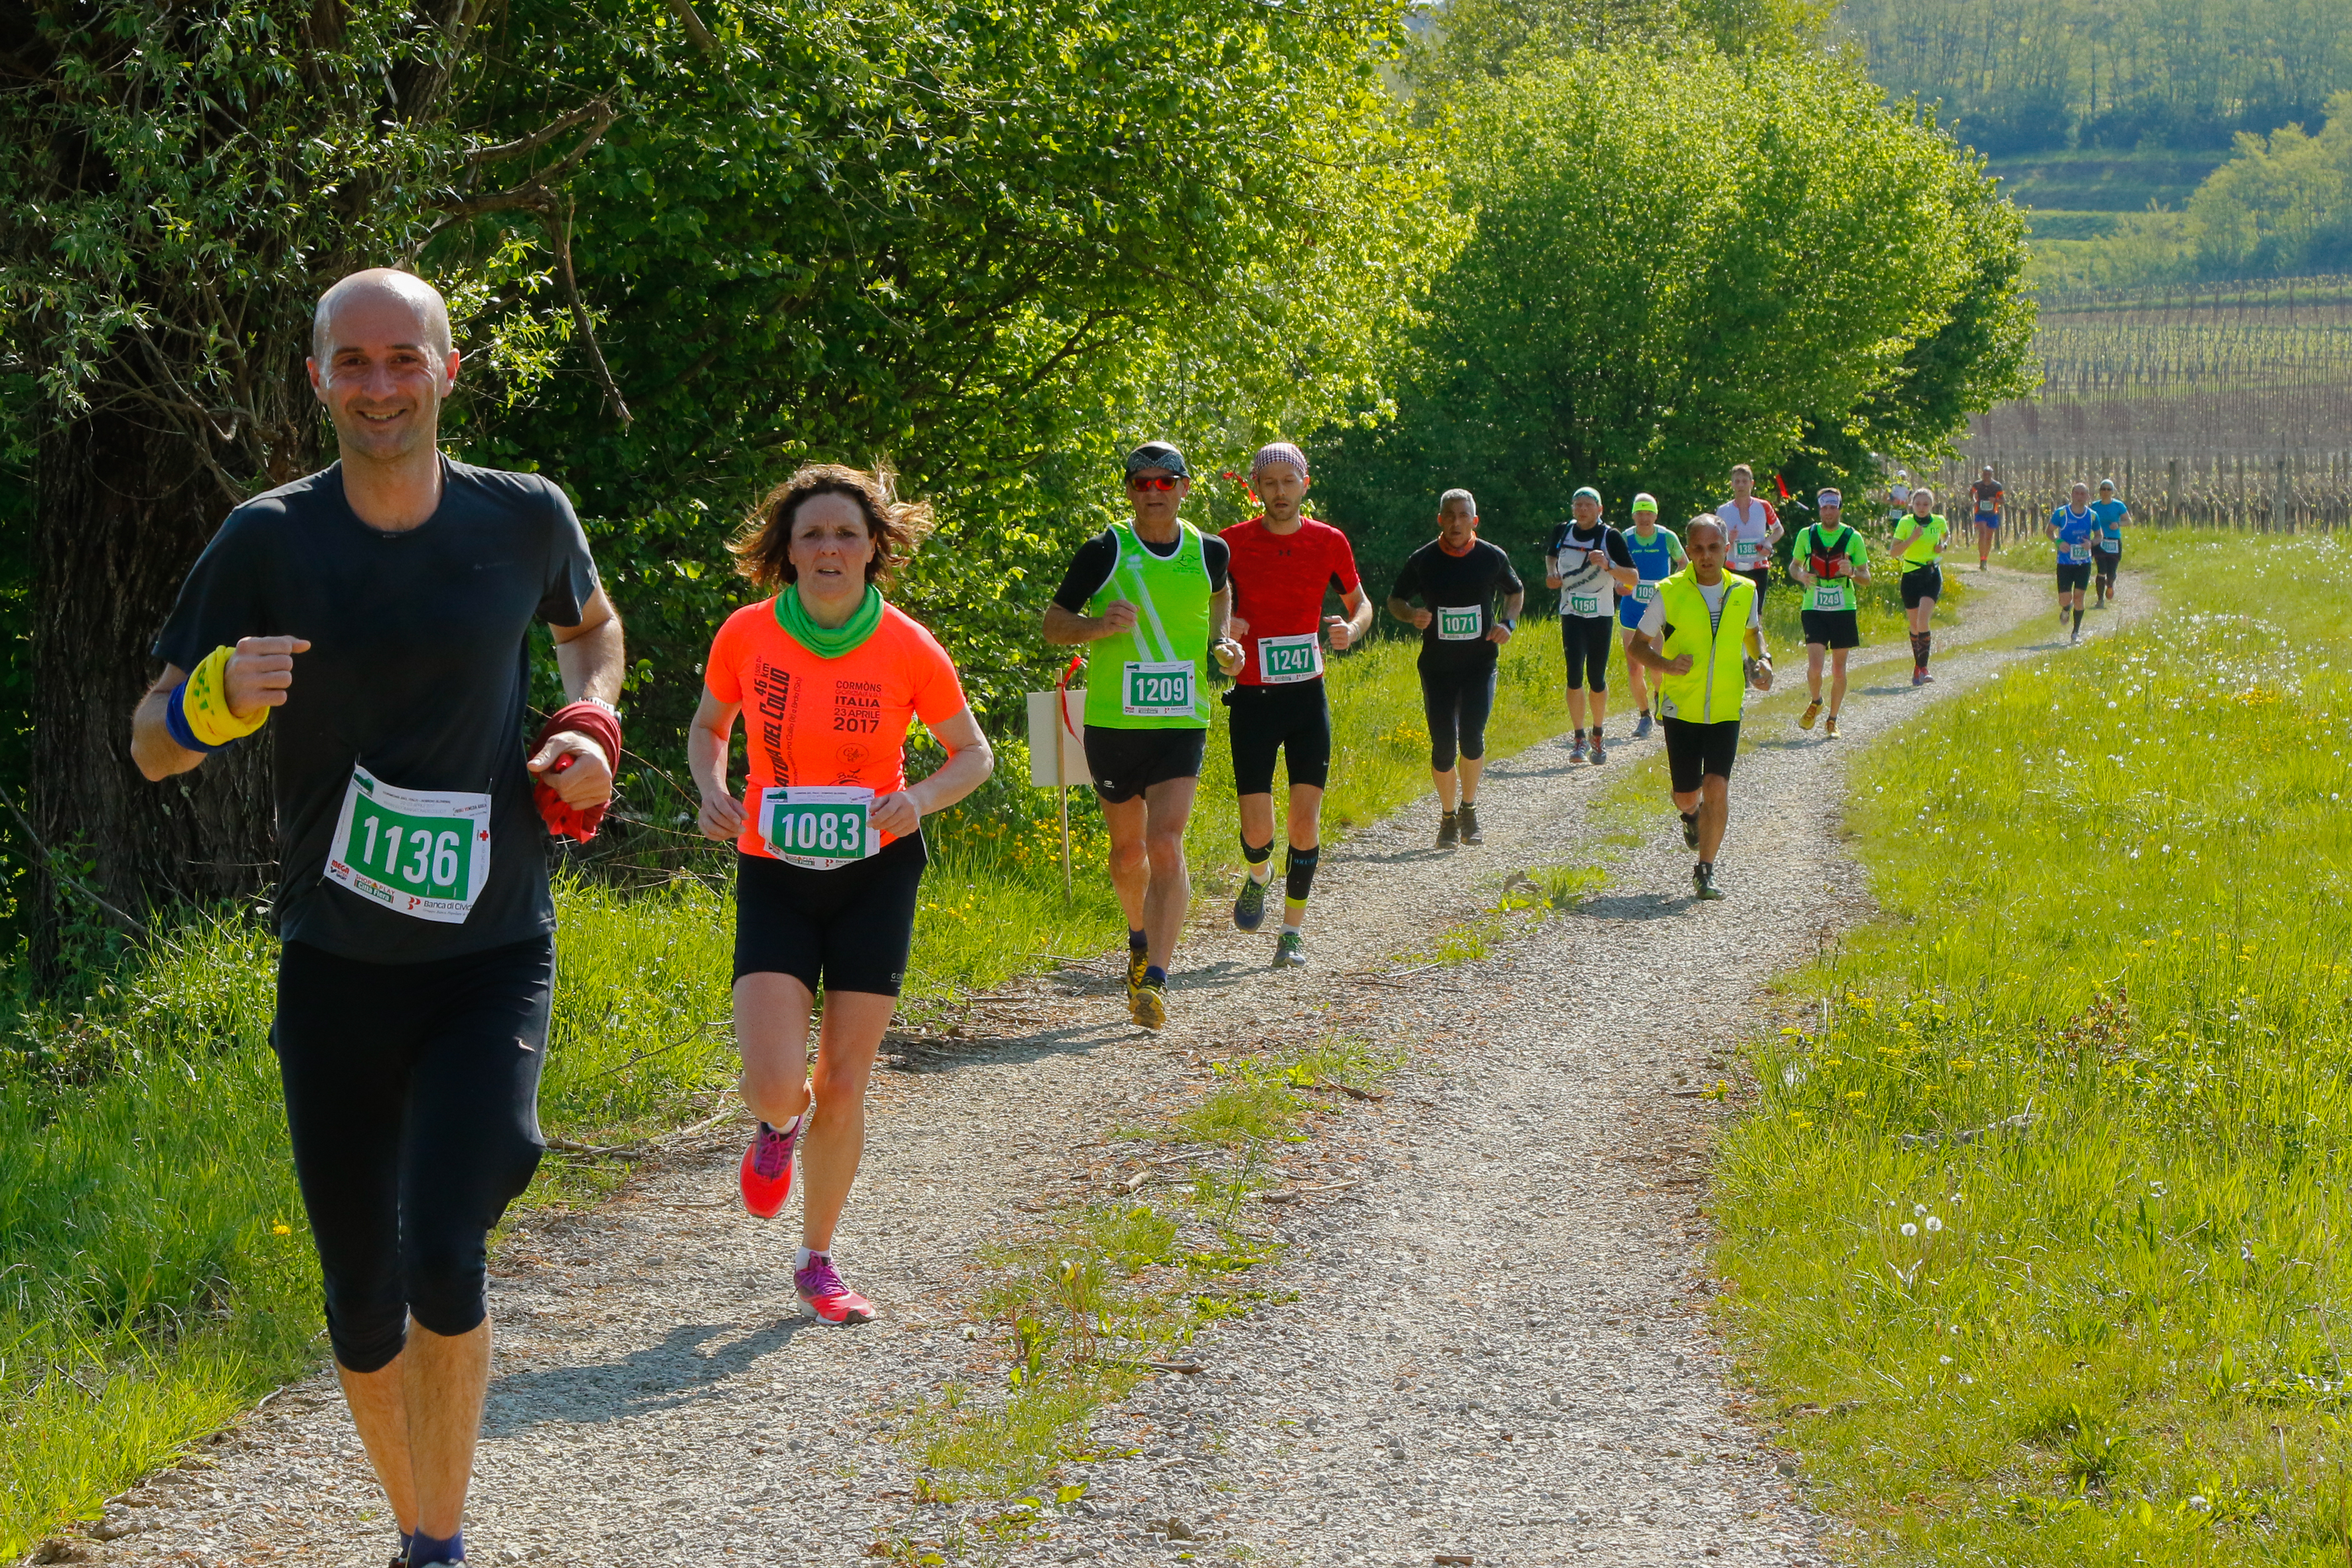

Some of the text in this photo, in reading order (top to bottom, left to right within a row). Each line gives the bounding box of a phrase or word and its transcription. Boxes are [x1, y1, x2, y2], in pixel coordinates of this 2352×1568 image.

[1638, 587, 1654, 597] 109
[1574, 599, 1595, 611] 1158
[1445, 616, 1474, 631] 1071
[1271, 648, 1309, 671] 1247
[754, 663, 769, 696] 46 km
[836, 680, 882, 692] CORMÒNS
[1136, 677, 1184, 701] 1209
[835, 695, 880, 708] ITALIA
[834, 708, 880, 719] 23 APRILE
[833, 717, 879, 734] 2017
[764, 720, 782, 749] DEL
[781, 813, 860, 850] 1083
[362, 815, 460, 887] 1136
[331, 859, 350, 874] MEGA
[356, 874, 395, 895] SHOP PLAY
[424, 900, 445, 909] Banca
